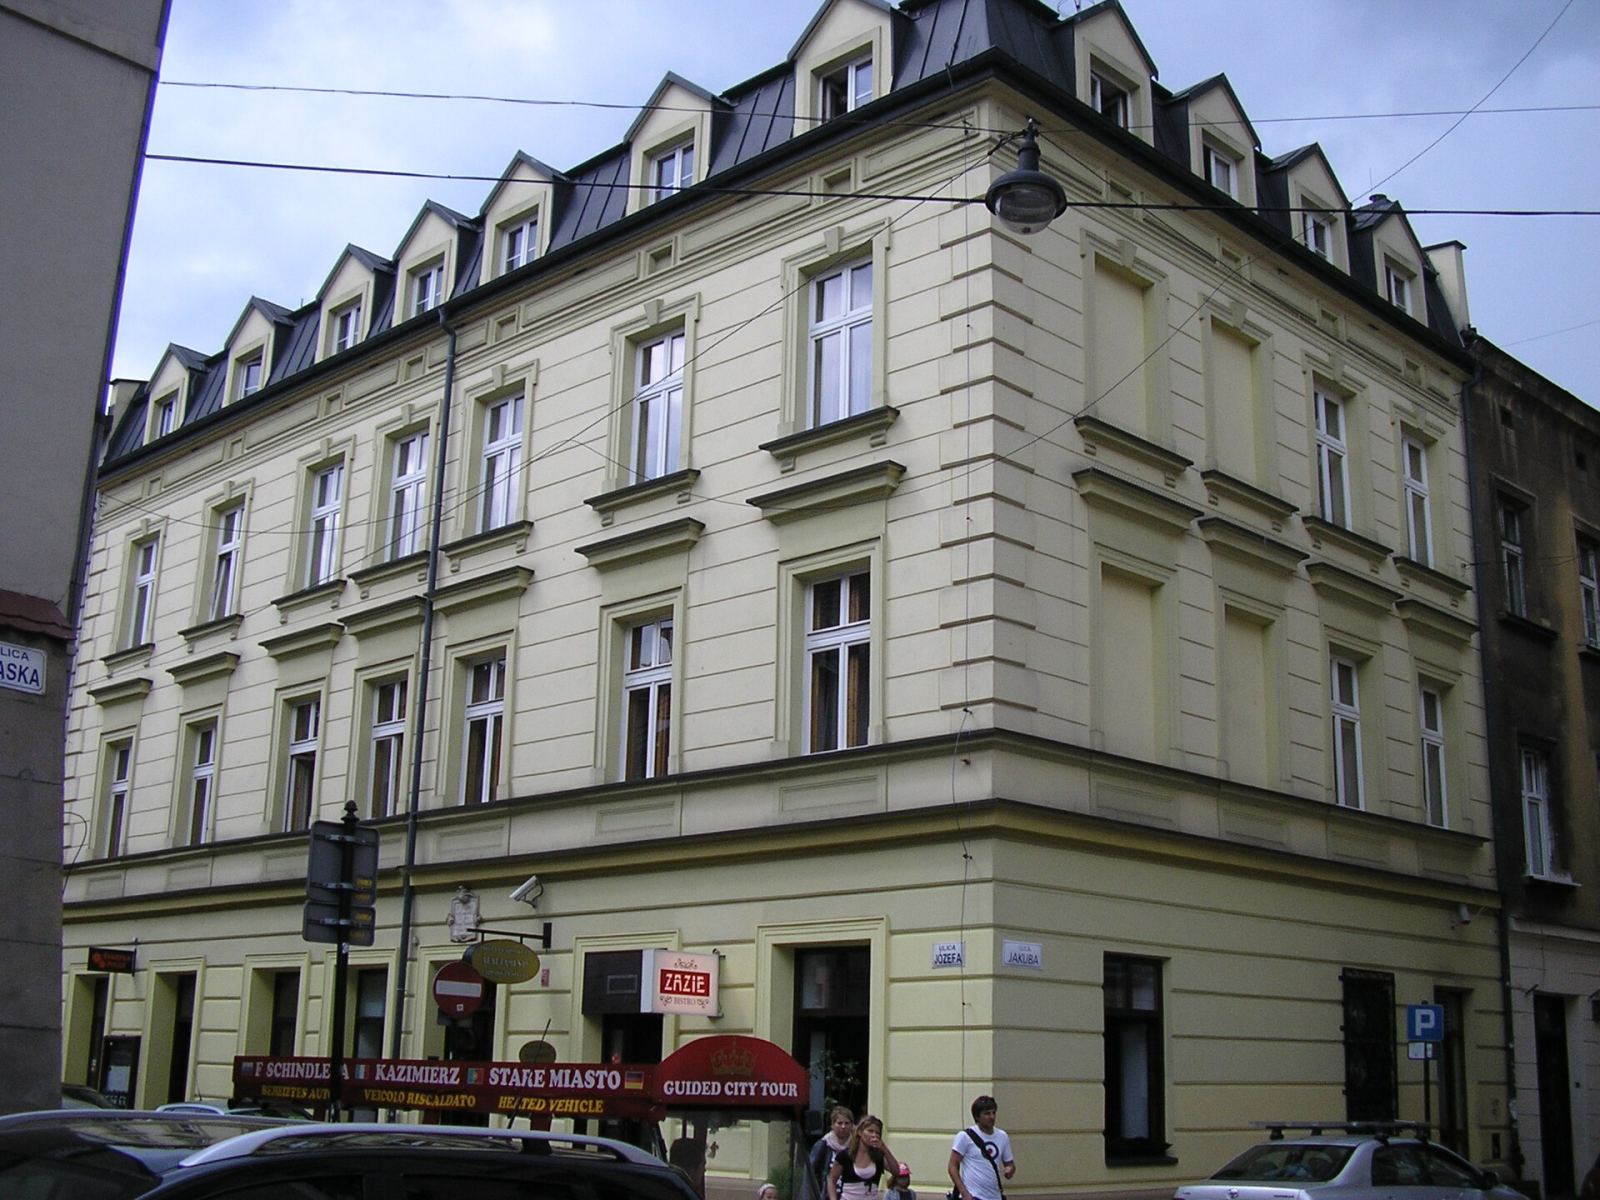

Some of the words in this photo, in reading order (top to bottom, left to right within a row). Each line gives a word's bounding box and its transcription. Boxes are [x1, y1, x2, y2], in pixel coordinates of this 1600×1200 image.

[1008, 951, 1039, 965] JAKUBA
[664, 973, 705, 993] ZAZIE
[1415, 1008, 1435, 1036] P
[266, 1062, 350, 1081] SCHINDLEA
[375, 1063, 460, 1085] KAZIMIERZ
[488, 1067, 545, 1088] STARE
[549, 1069, 621, 1090] MIASTO
[364, 1088, 405, 1103] VEICOLO
[406, 1092, 476, 1107] RISCALDATO
[663, 1080, 721, 1096] GUIDED
[724, 1081, 758, 1096] CITY
[760, 1082, 798, 1097] TOUR
[549, 1098, 604, 1113] VEHICLE
